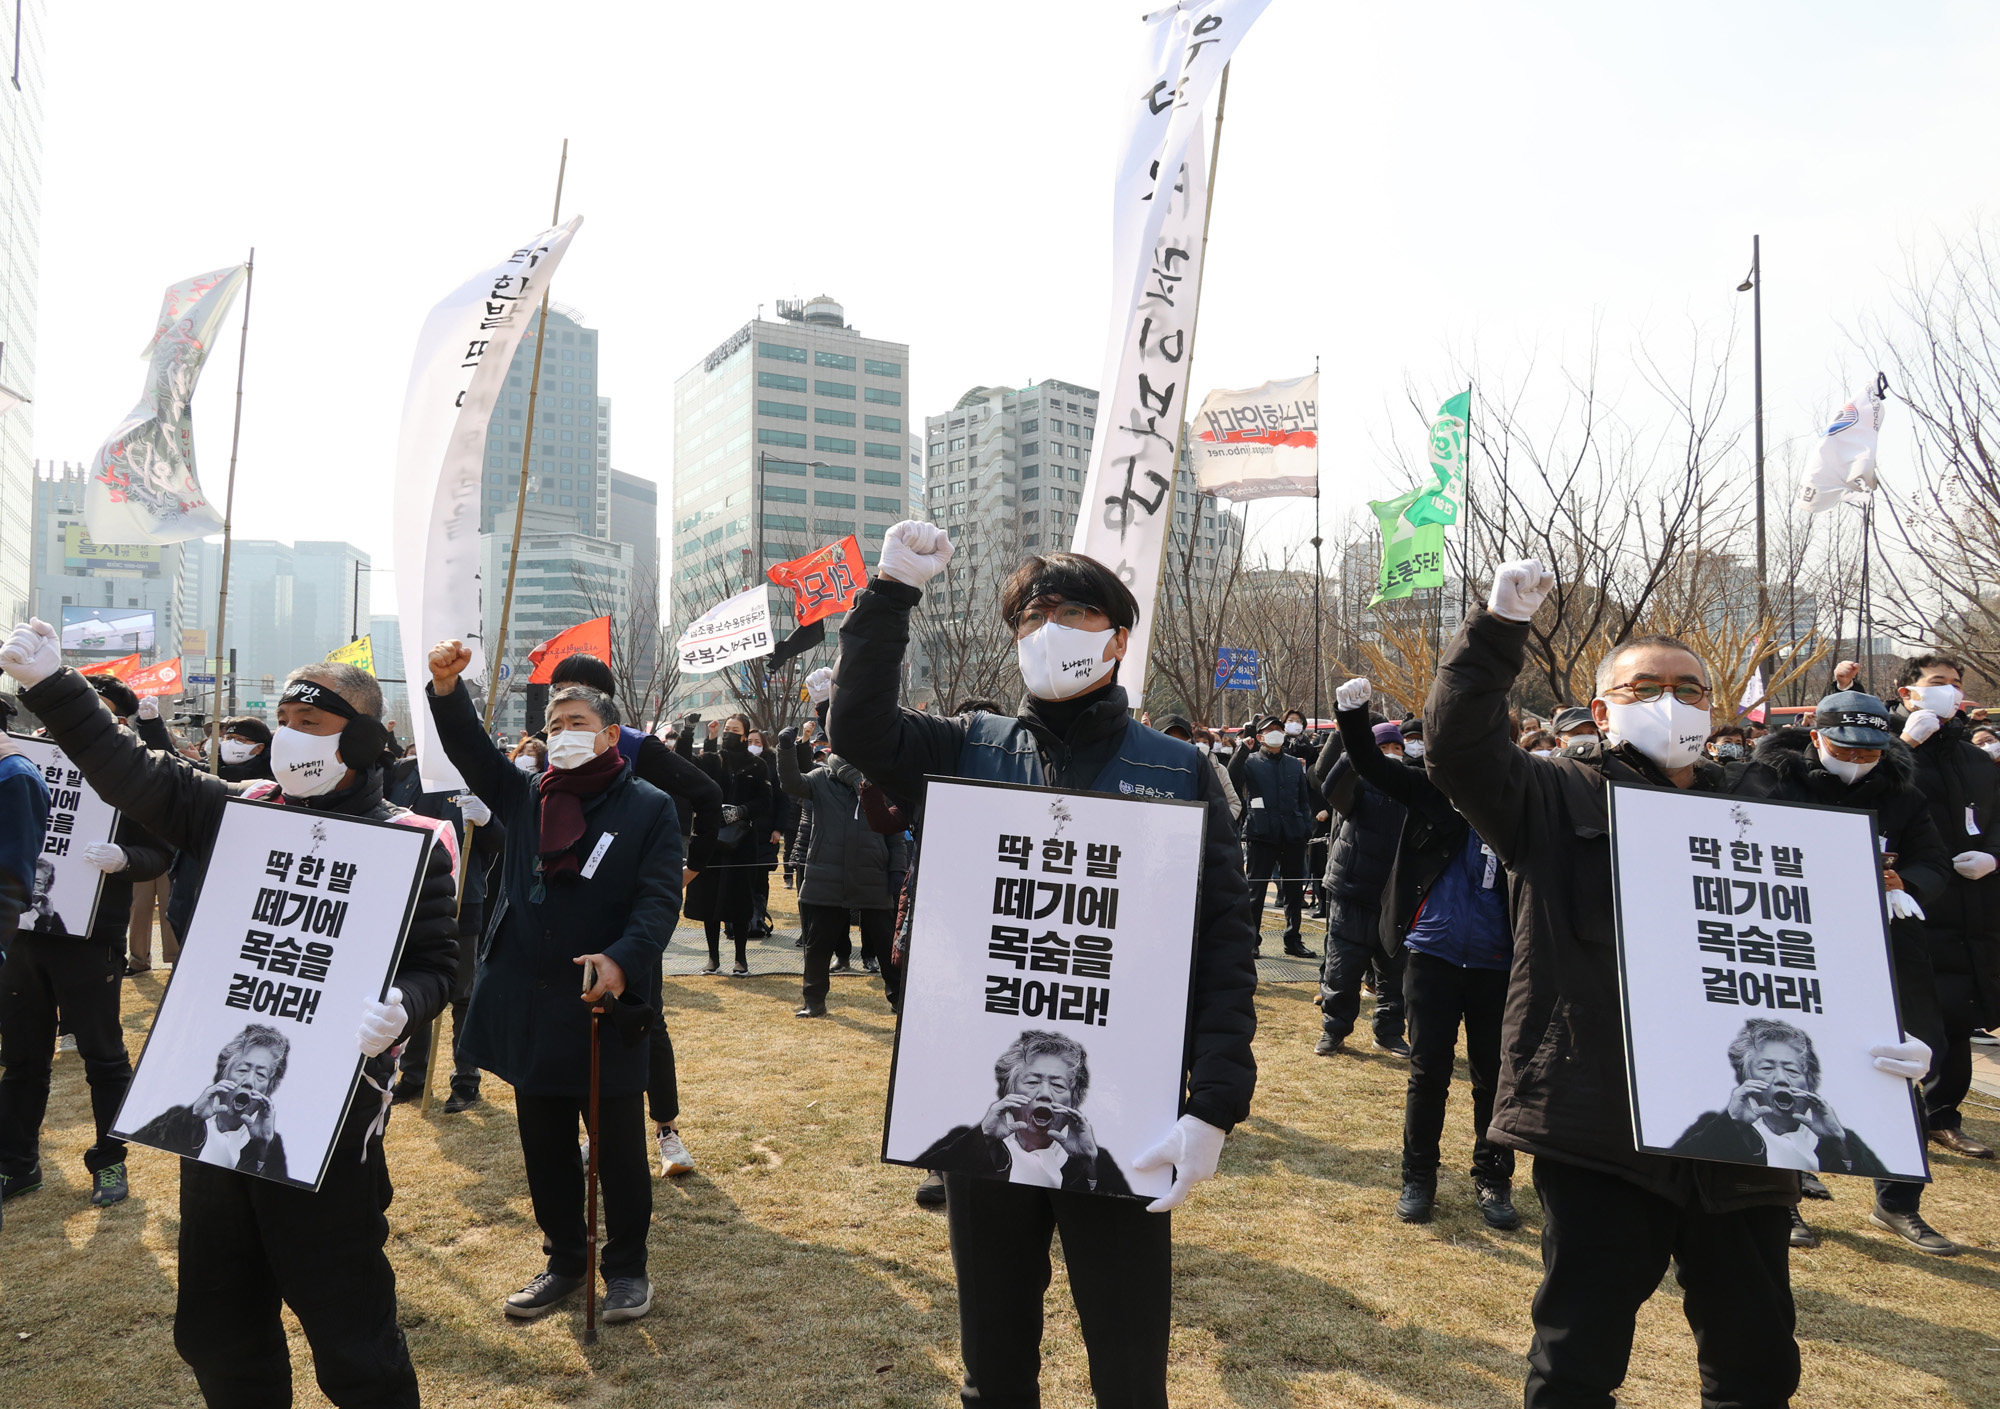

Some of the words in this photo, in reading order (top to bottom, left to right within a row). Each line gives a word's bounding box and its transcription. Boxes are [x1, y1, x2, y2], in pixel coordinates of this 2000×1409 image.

[1062, 658, 1093, 671] 노나메기
[1075, 667, 1092, 678] 세상
[44, 766, 63, 784] 한
[66, 769, 85, 788] 발
[289, 760, 324, 772] 노나메기
[303, 768, 323, 777] 세상
[265, 849, 294, 883] 딱
[295, 855, 325, 889] 한
[327, 860, 358, 894] 발
[998, 834, 1034, 871] 딱
[1041, 838, 1078, 875] 한
[1086, 842, 1122, 880] 발
[1688, 836, 1722, 870] 딱
[1729, 840, 1763, 874] 한
[1770, 845, 1804, 879] 발
[251, 887, 349, 939] 떼기에
[992, 876, 1120, 930] 떼기에
[1692, 875, 1812, 925] 떼기에
[239, 928, 334, 983] 목숨을
[988, 924, 1113, 980] 목숨을
[1697, 919, 1817, 971] 목숨을
[225, 972, 322, 1025] 걸어라!
[985, 974, 1110, 1027] 걸어라!
[1701, 966, 1823, 1015] 걸어라!
